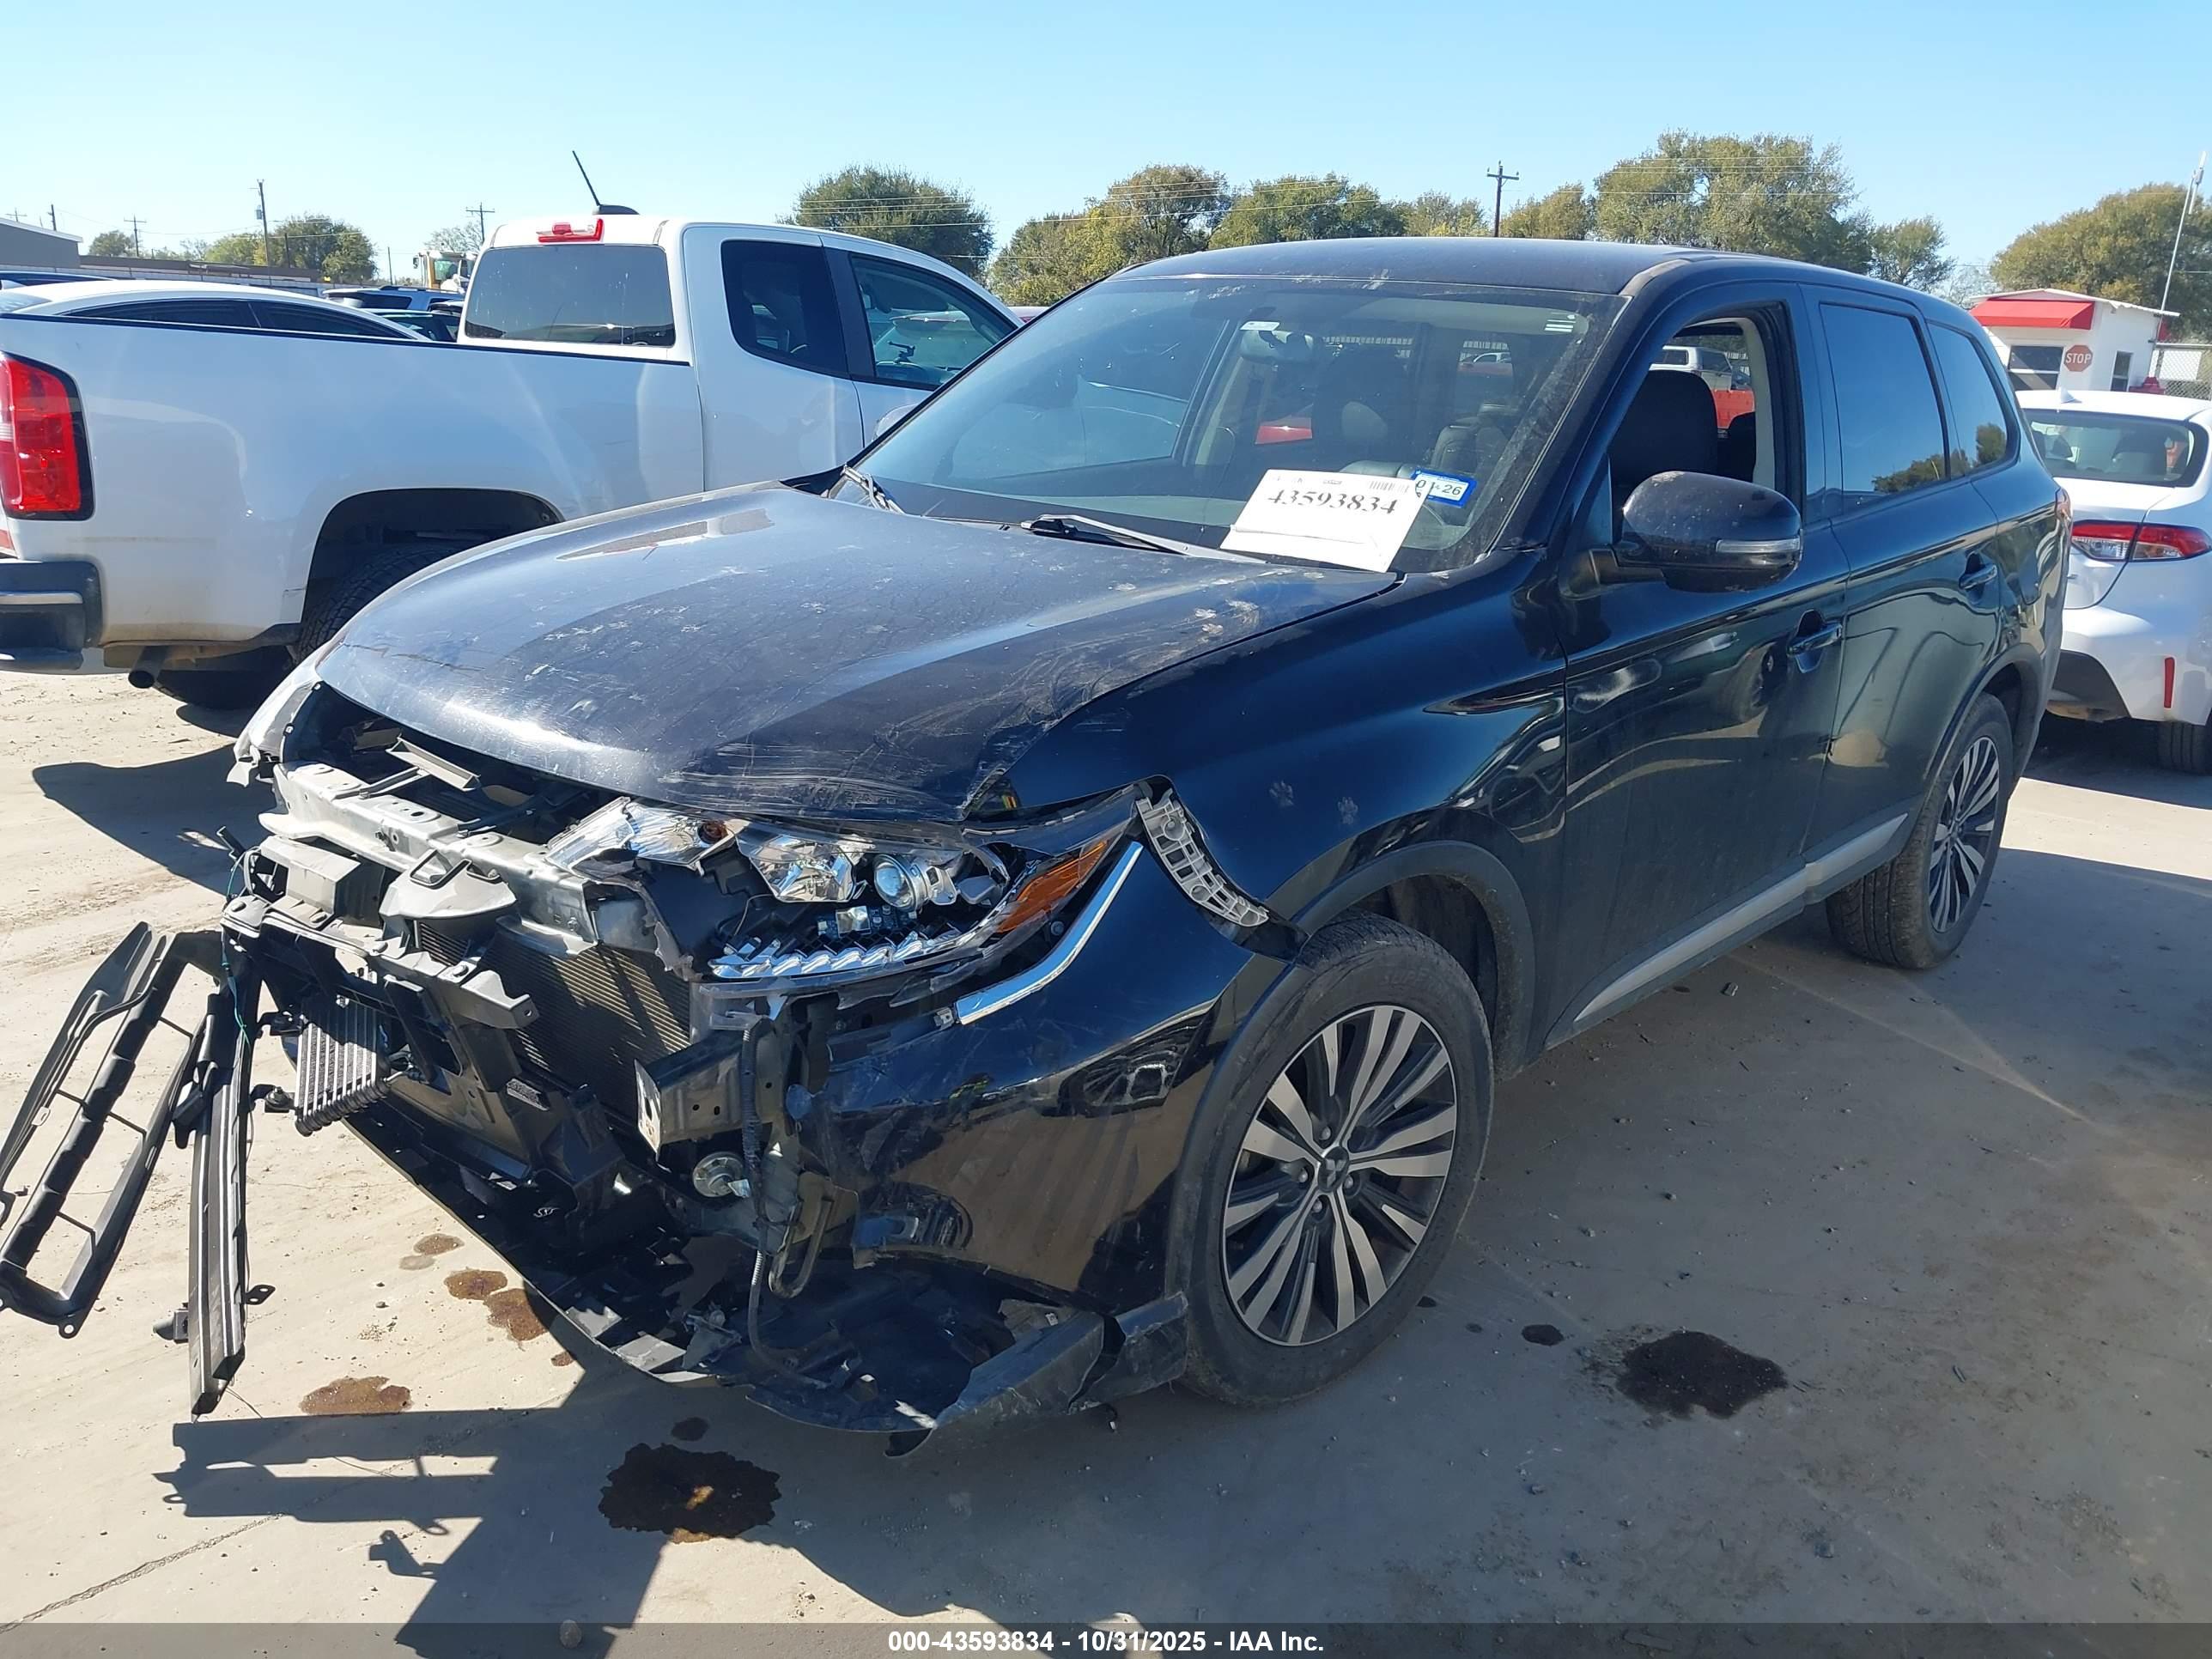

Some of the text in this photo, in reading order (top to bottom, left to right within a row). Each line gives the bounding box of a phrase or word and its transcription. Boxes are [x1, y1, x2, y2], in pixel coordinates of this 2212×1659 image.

[2065, 353, 2091, 364] STOP
[1442, 484, 1462, 495] 26
[1267, 489, 1398, 514] 43593834
